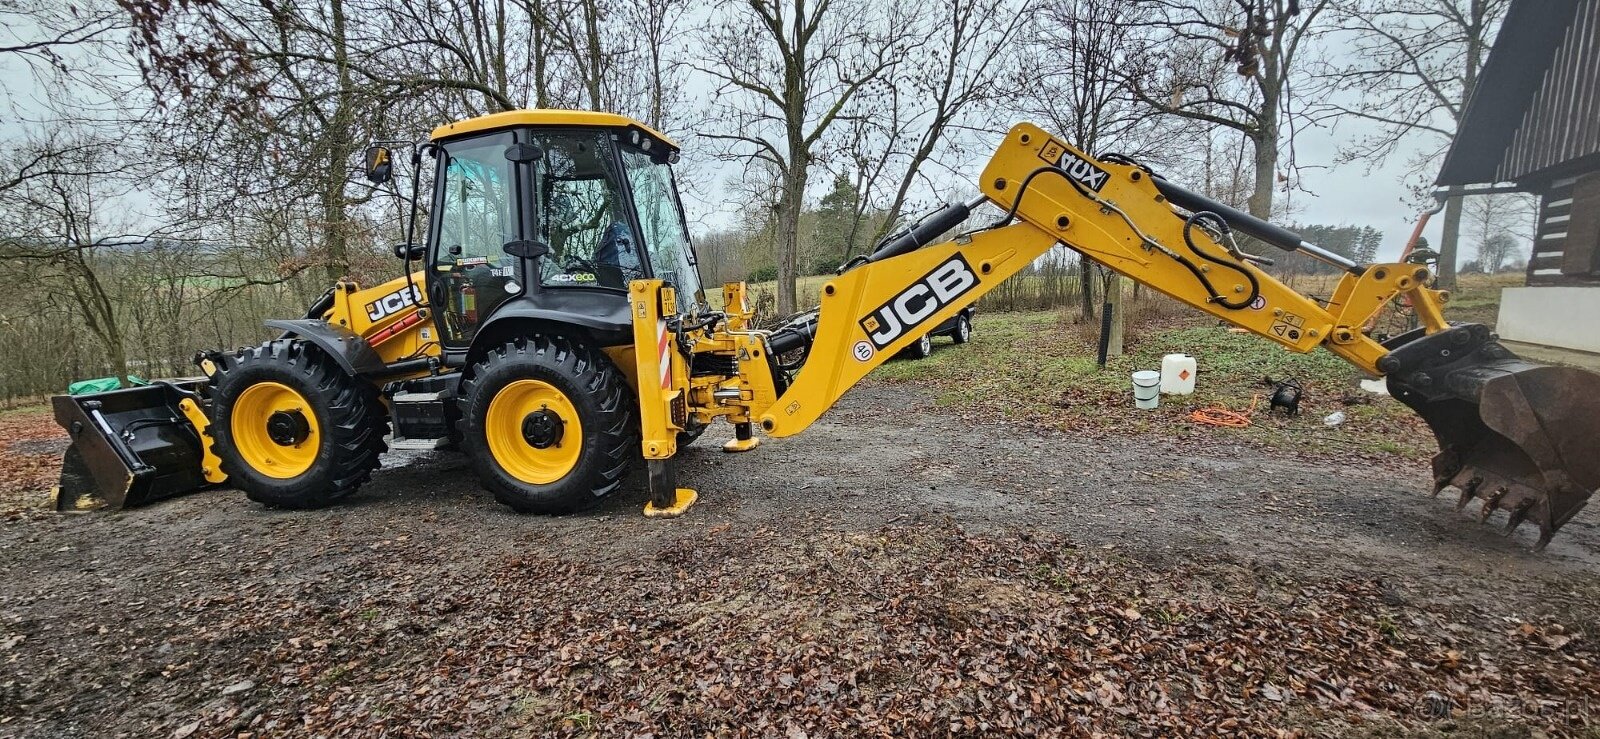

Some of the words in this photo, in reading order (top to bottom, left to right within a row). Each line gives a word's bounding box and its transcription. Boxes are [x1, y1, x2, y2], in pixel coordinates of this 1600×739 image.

[369, 284, 422, 321] JCB
[872, 259, 975, 345] JCB
[857, 344, 871, 359] 40
